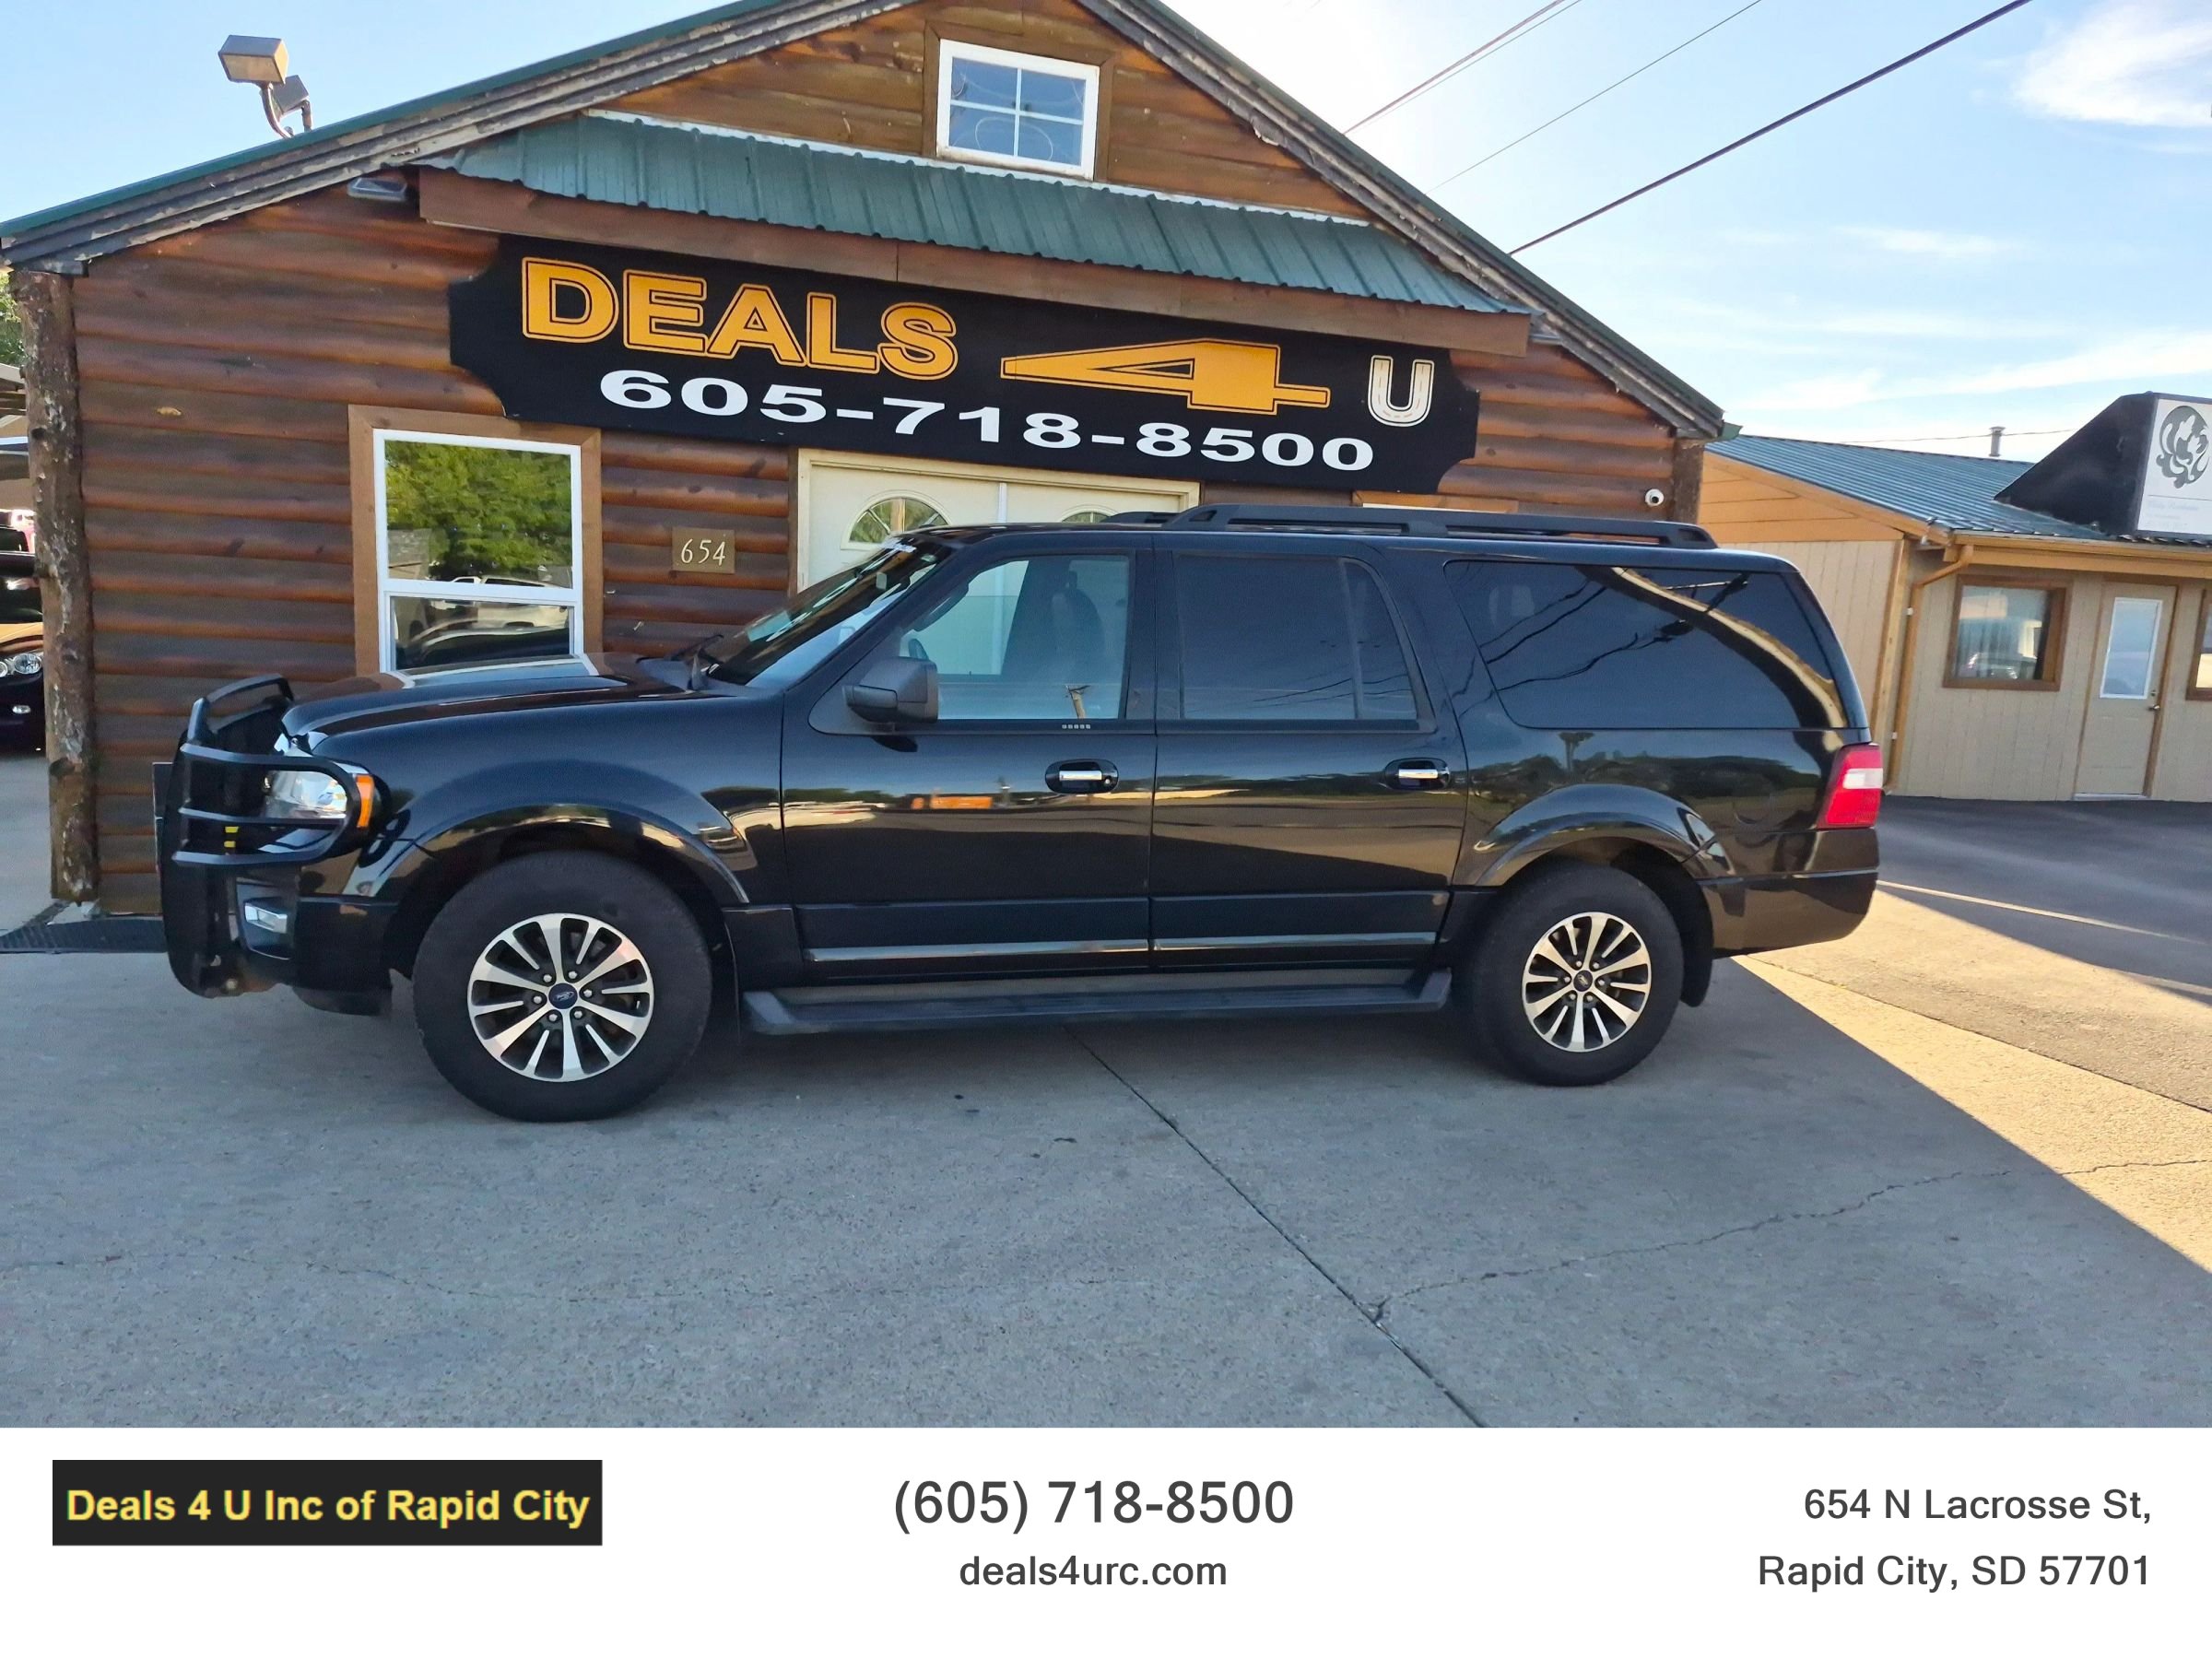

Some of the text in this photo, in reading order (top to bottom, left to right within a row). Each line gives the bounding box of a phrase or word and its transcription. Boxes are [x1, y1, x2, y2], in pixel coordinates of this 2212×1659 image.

[522, 257, 1435, 428] DEALS 4 U
[600, 370, 1374, 471] 605-718-8500
[680, 538, 726, 566] 654
